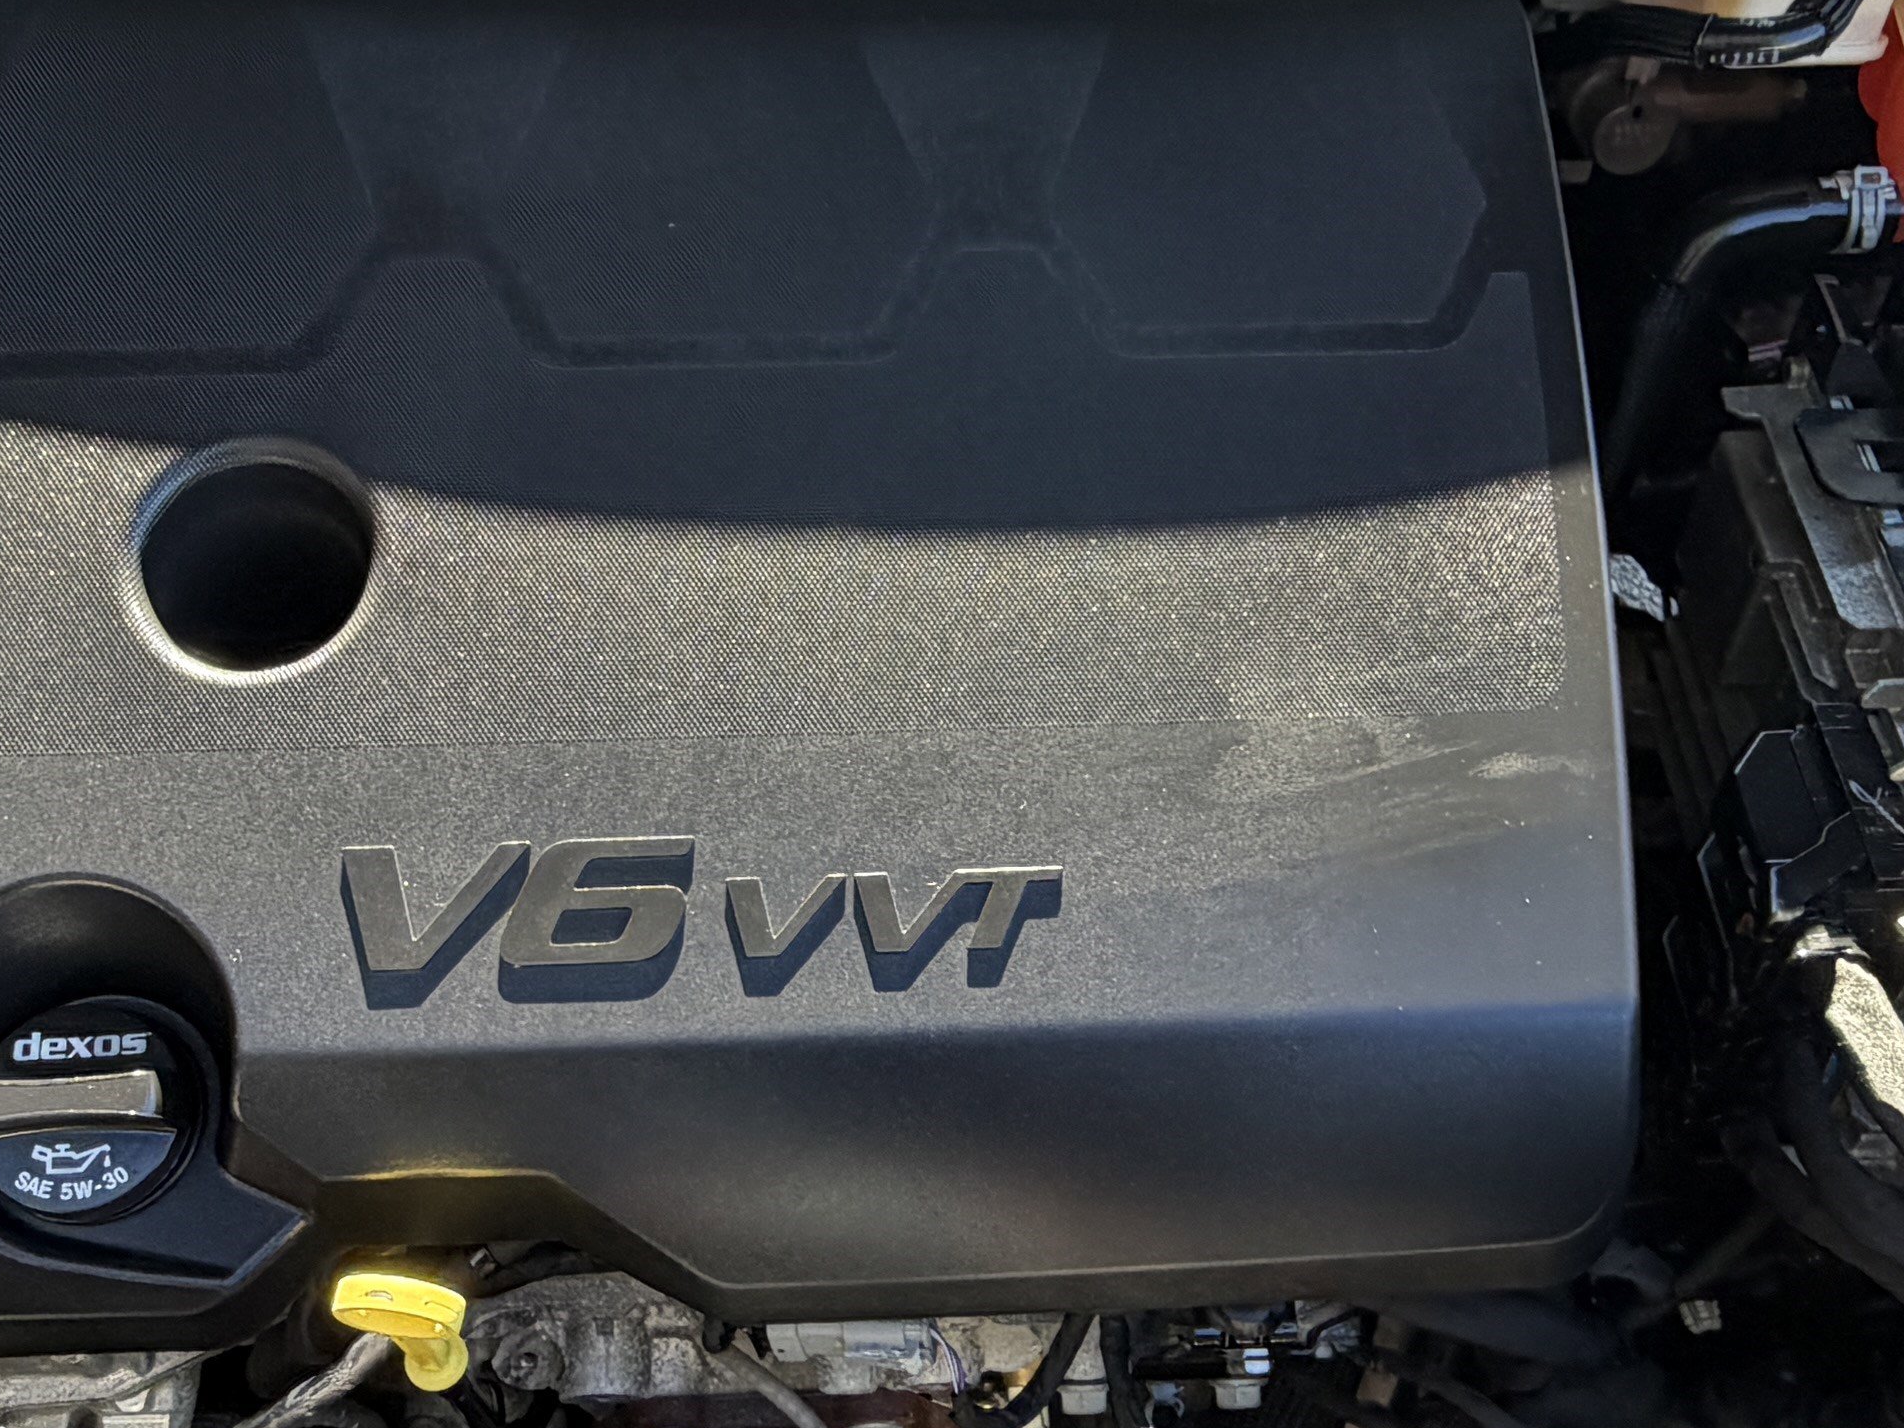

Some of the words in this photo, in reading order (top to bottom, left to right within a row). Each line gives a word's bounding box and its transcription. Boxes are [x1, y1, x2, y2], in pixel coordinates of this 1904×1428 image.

[341, 836, 694, 1009] V6
[725, 866, 1062, 996] VVT
[13, 1031, 152, 1062] dexos
[14, 1171, 54, 1200] SAE
[59, 1166, 130, 1201] 5W-30
